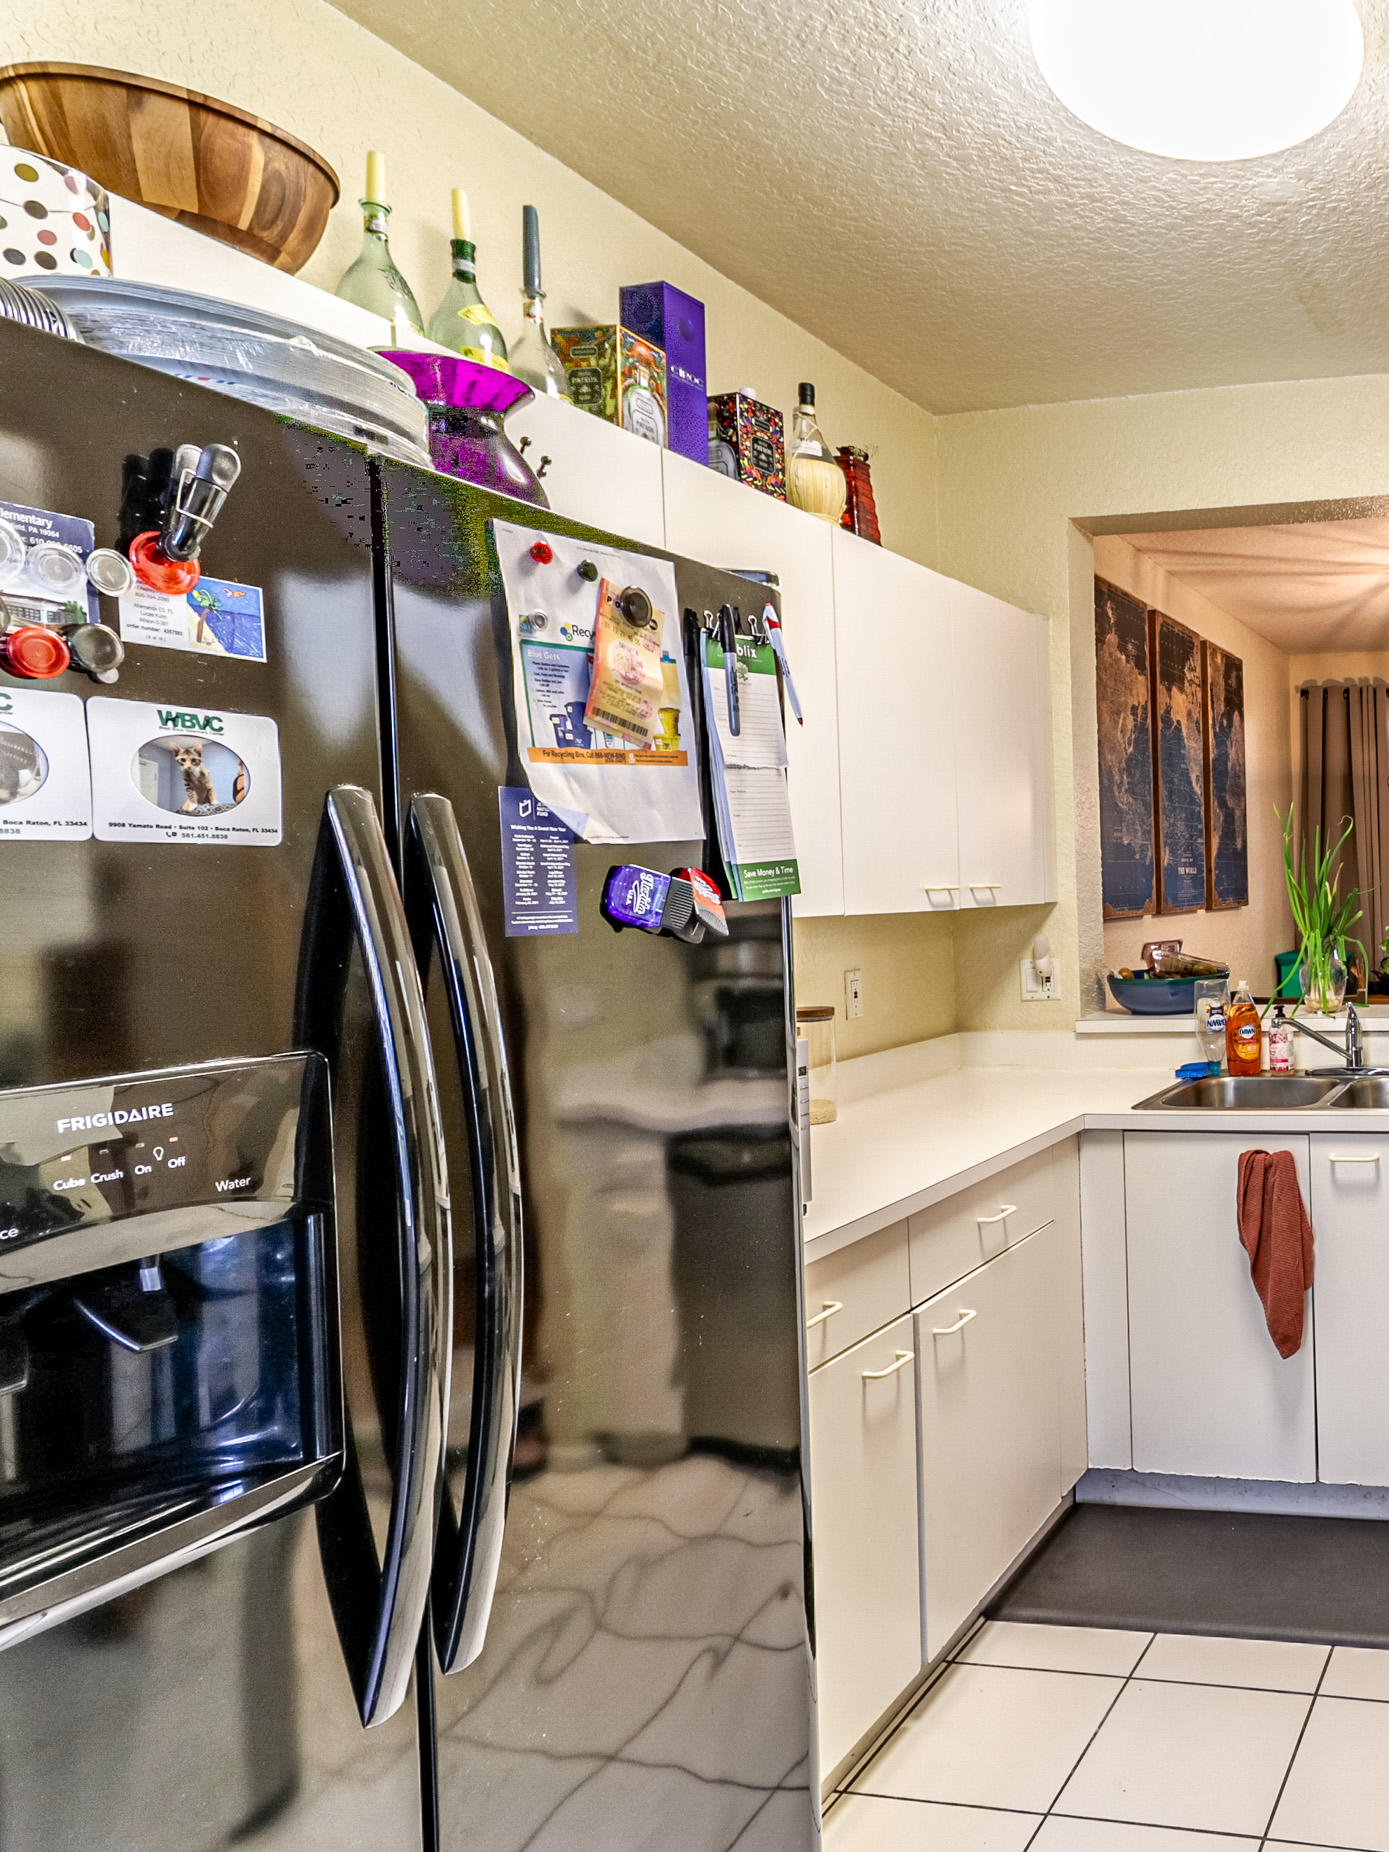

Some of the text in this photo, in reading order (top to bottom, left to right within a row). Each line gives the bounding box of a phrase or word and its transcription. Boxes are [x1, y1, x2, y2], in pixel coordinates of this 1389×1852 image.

[0, 508, 53, 529] lementary
[572, 625, 596, 639] Recy
[736, 643, 757, 659] blix
[156, 709, 224, 732] WBVC
[743, 869, 757, 878] Save
[757, 868, 775, 878] Money
[781, 865, 794, 874] Time
[1239, 1027, 1257, 1035] DAWN
[57, 1102, 175, 1134] FRIGIDAIRE
[134, 1156, 187, 1176] On Off
[53, 1168, 124, 1192] Cube Crush
[215, 1174, 252, 1193] Water
[0, 1228, 19, 1240] ce
